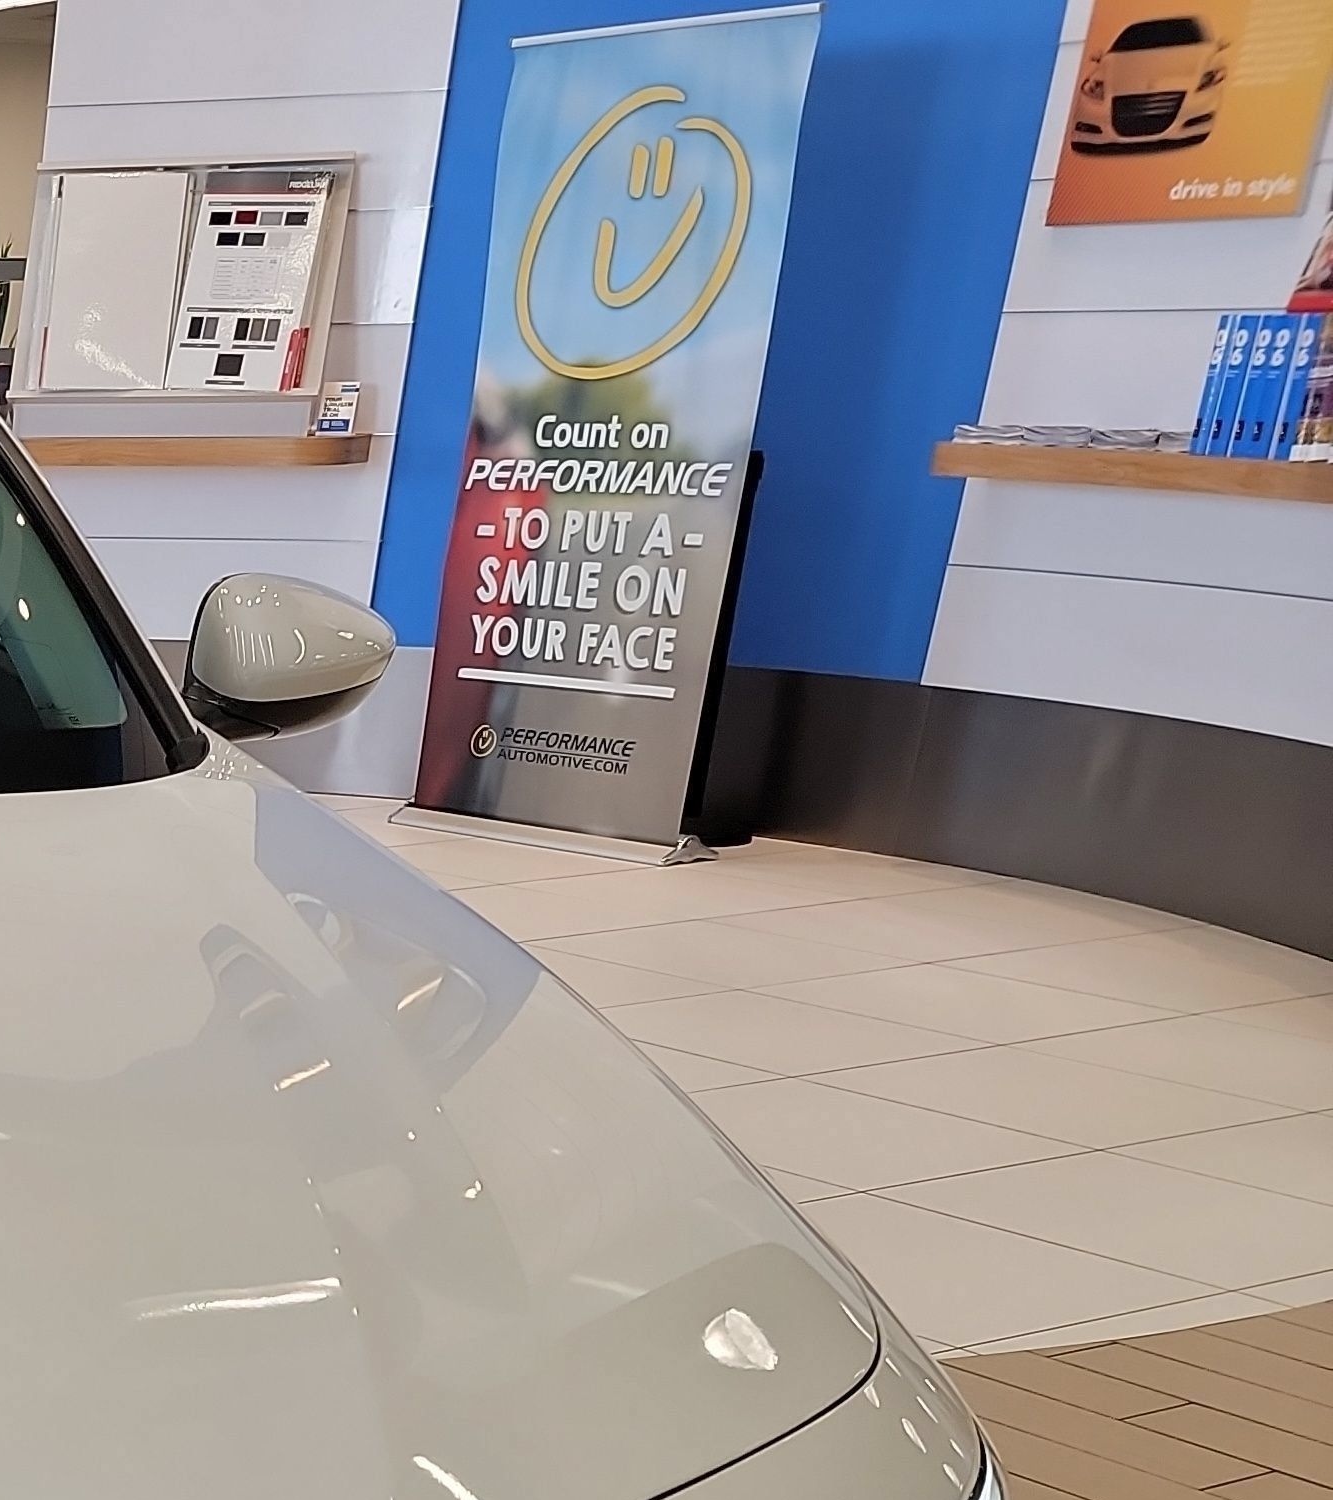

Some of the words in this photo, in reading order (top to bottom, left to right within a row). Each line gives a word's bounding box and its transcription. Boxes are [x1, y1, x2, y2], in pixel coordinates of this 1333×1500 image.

[1169, 177, 1219, 201] drive
[1222, 177, 1243, 197] in
[1247, 173, 1296, 203] style
[535, 415, 622, 448] Count
[631, 422, 669, 449] on
[465, 459, 733, 497] PERFORMANCE
[504, 507, 550, 549] TO
[561, 510, 633, 554] PUT
[640, 513, 673, 557] A
[476, 556, 602, 610] SMILE
[615, 565, 687, 616] ON
[471, 614, 567, 661] YOUR
[577, 623, 677, 672] FACE
[500, 727, 637, 758] PERFORMANCE
[497, 748, 628, 775] AUTOMOTIVE.COM
